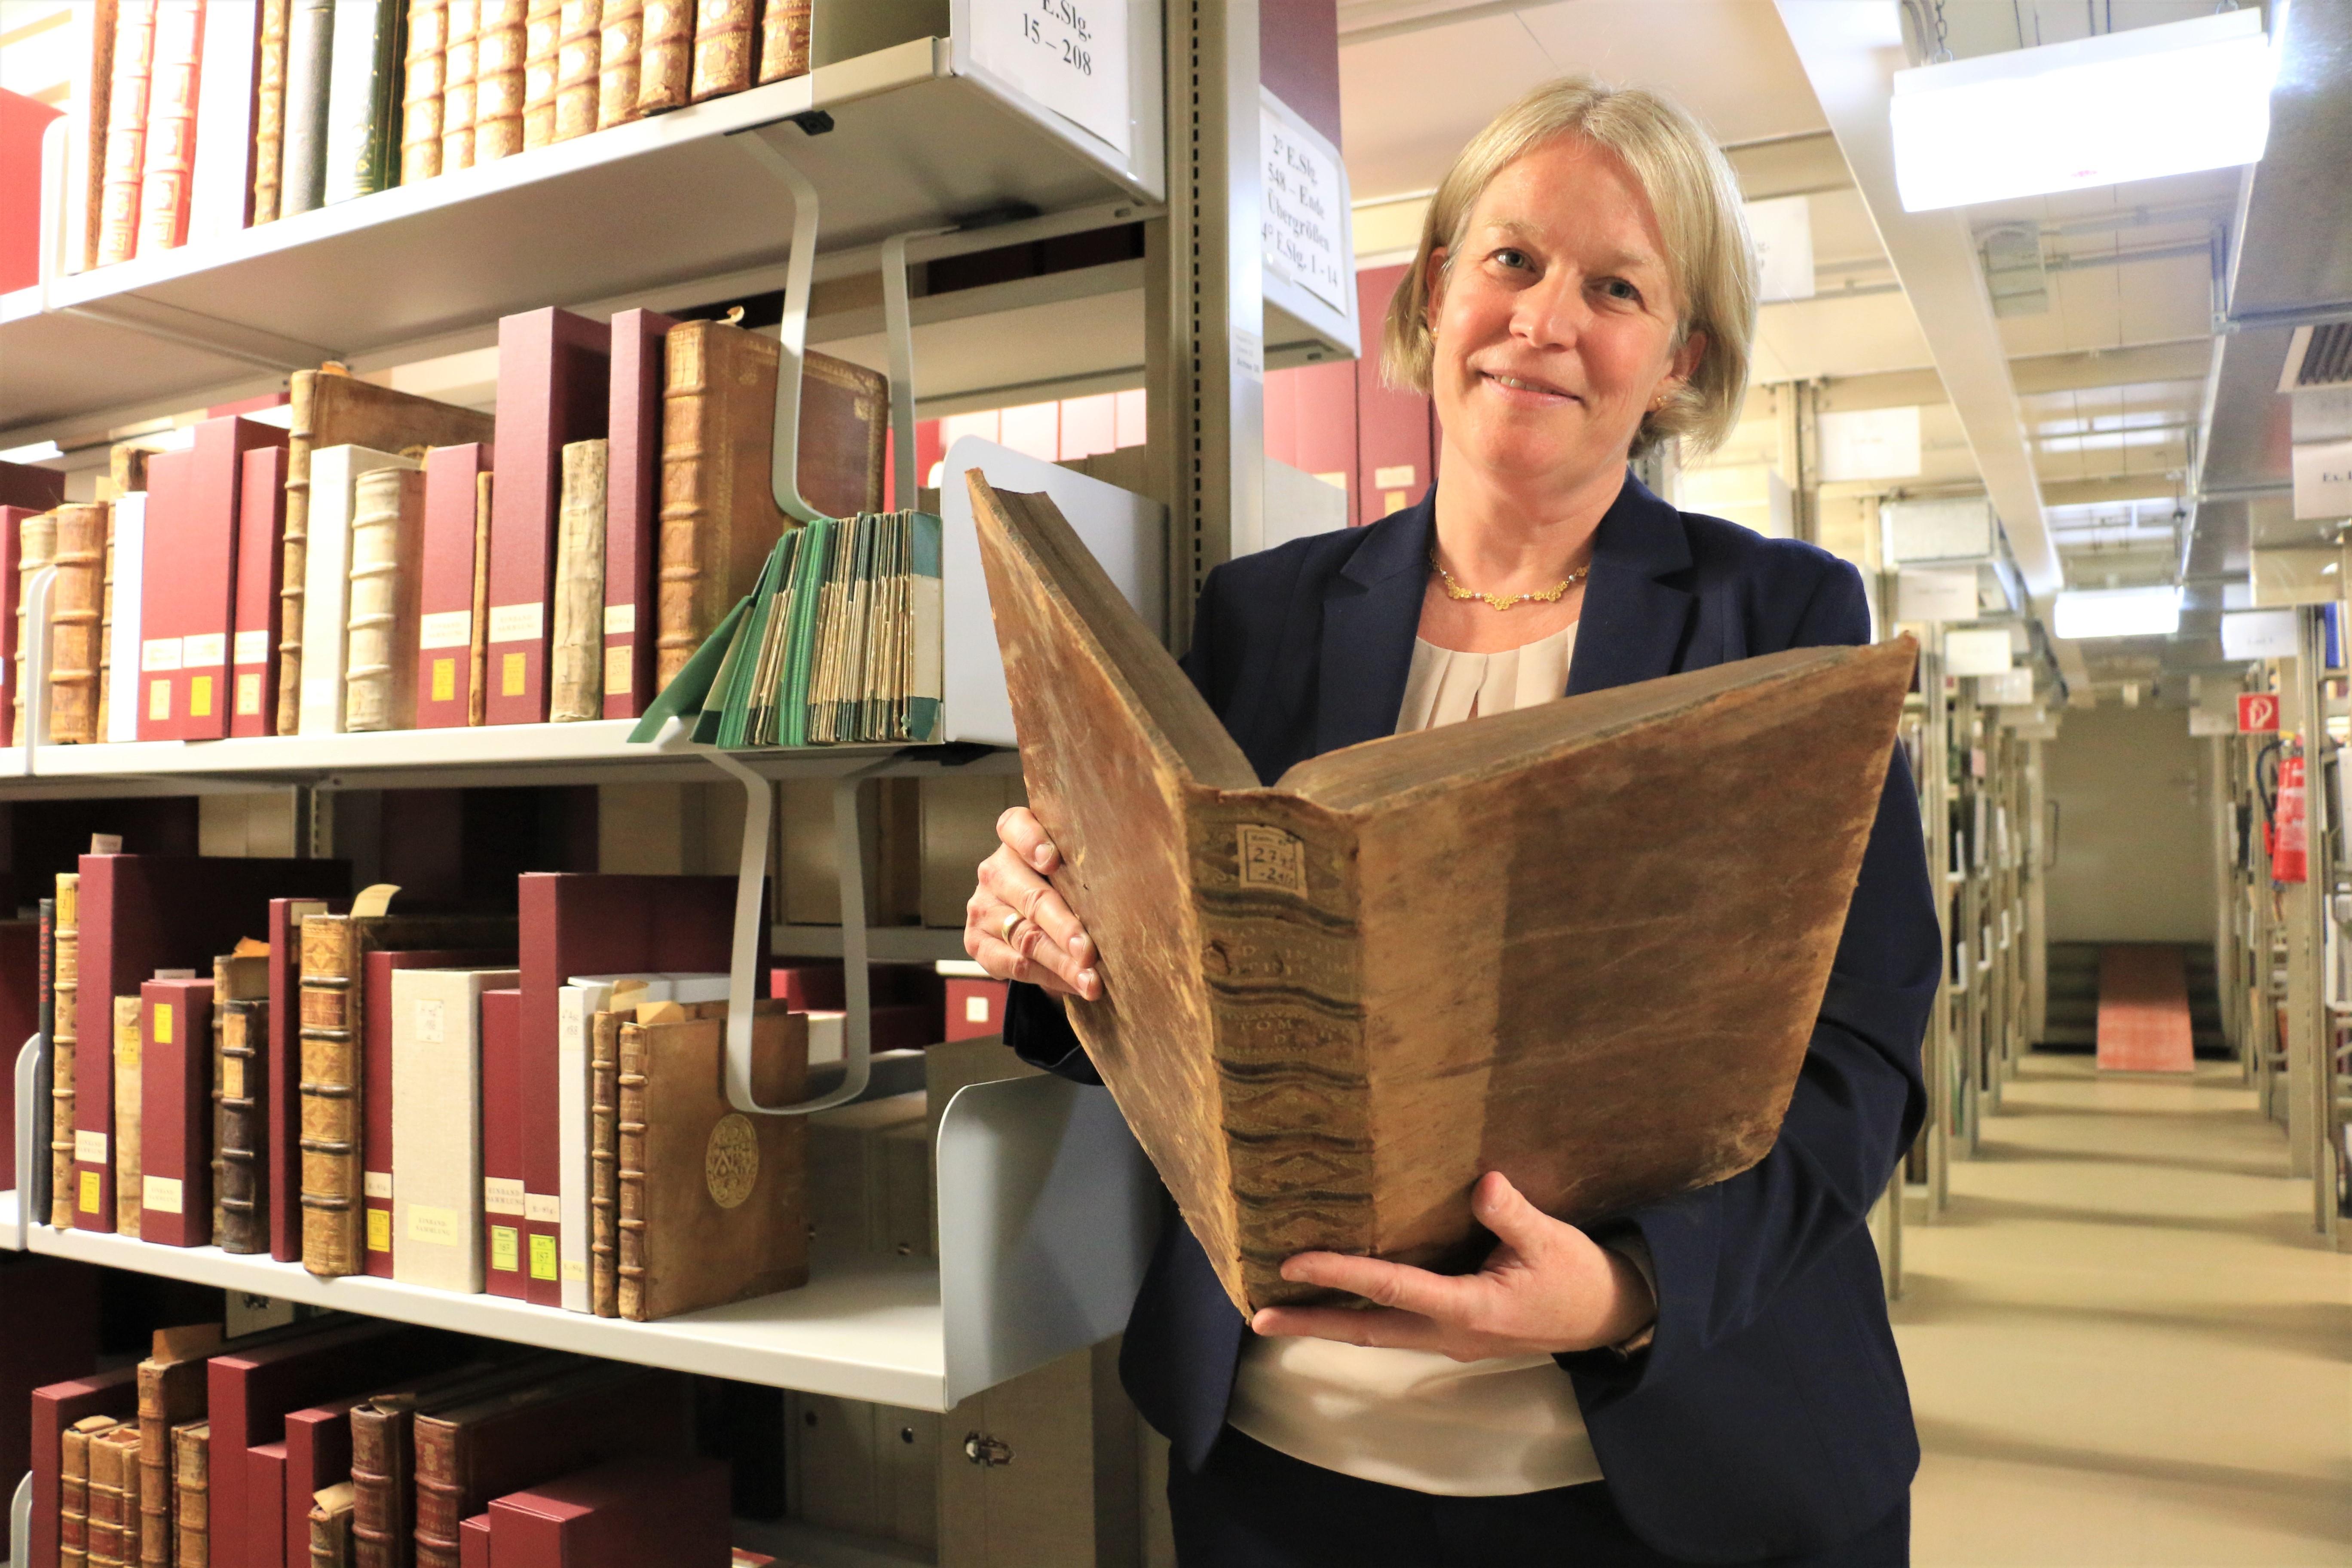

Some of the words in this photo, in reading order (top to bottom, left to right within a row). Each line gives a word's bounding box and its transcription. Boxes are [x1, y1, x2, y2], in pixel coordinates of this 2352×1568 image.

[1023, 13, 1040, 44] 15
[1062, 38, 1091, 76] 208
[1300, 184, 1324, 220] Ende
[1327, 264, 1338, 287] 14
